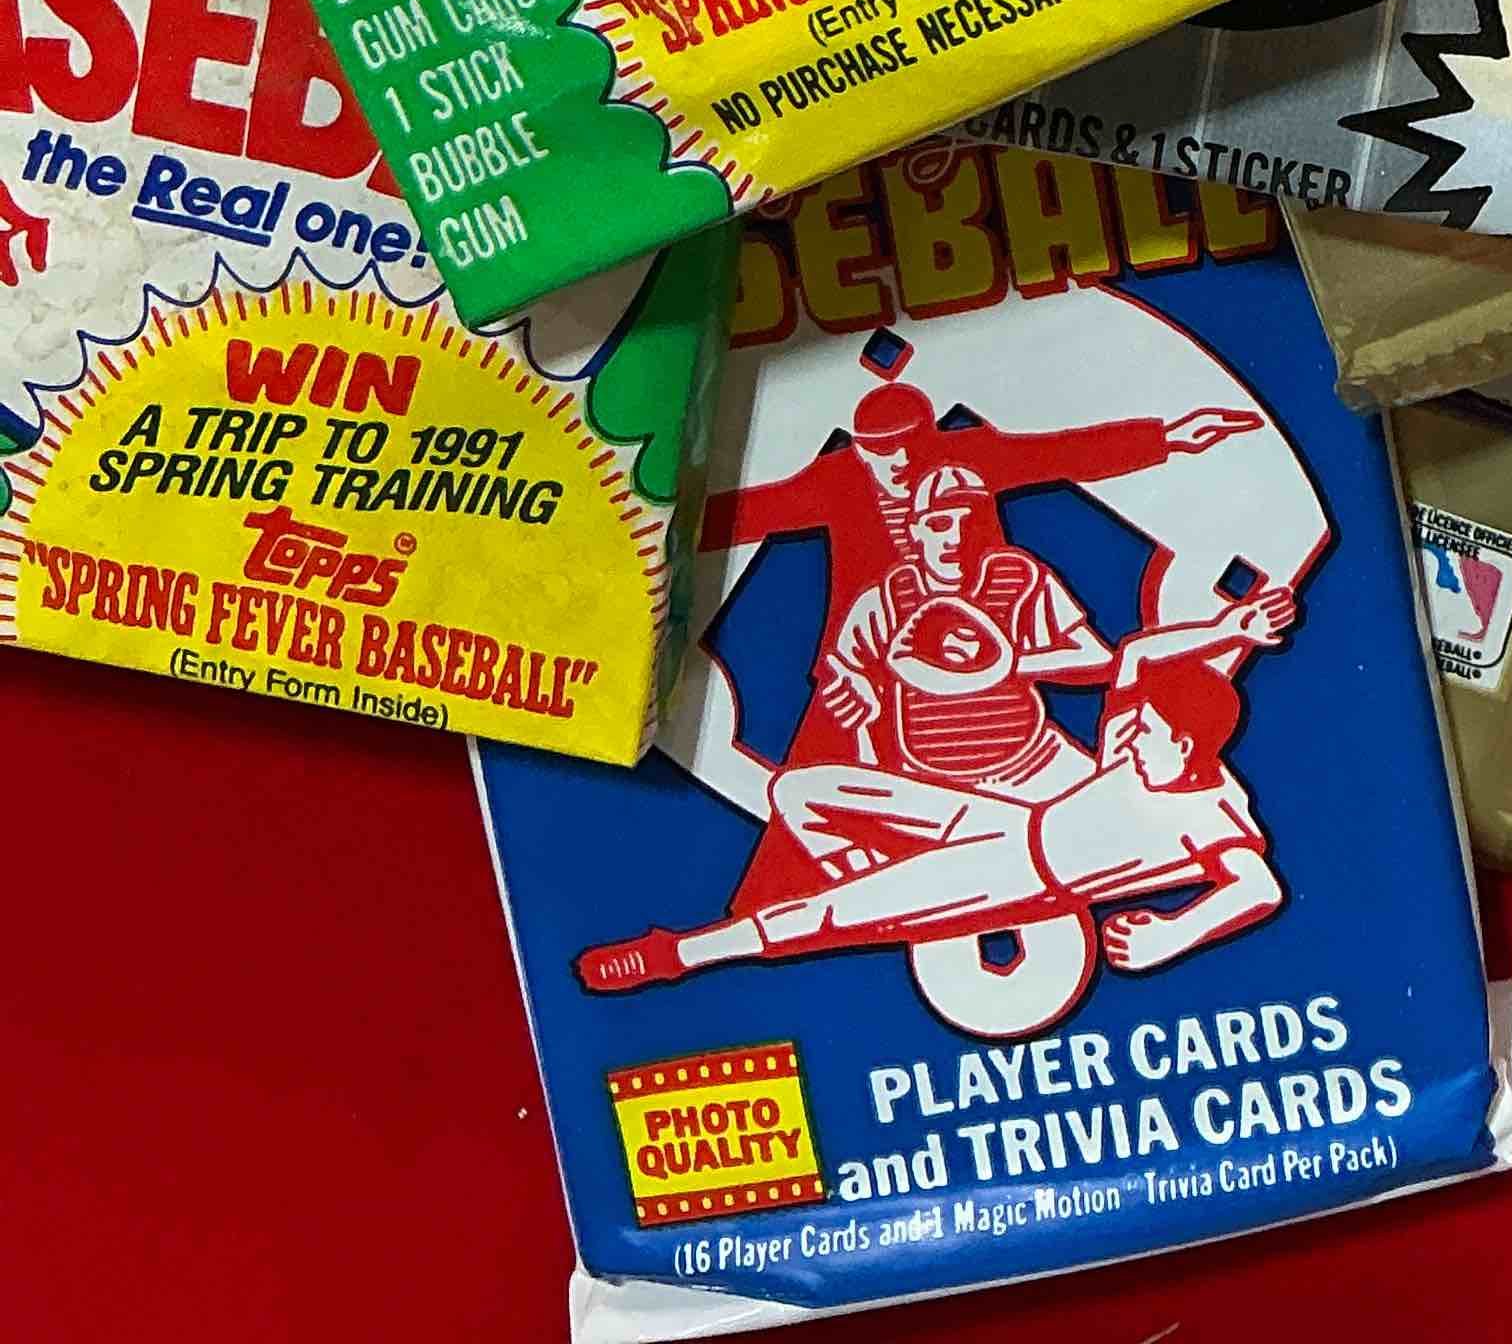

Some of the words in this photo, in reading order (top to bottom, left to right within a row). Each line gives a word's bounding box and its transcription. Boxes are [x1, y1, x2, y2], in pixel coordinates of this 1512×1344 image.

[352, 2, 432, 72] GUM
[420, 42, 525, 121] STICK
[710, 88, 763, 137] NO
[766, 24, 921, 120] PURCHASE
[408, 110, 550, 204] BUBBLE
[21, 128, 128, 197] the
[131, 153, 291, 248] Real
[294, 201, 431, 270] one!
[438, 196, 529, 271] GUM
[223, 337, 423, 417] WIN
[119, 407, 165, 450] A
[185, 407, 308, 458] TRIP
[324, 417, 393, 464] TO
[409, 426, 525, 473] 1991
[89, 449, 294, 504] SPRING
[309, 467, 566, 525] TRAINING
[167, 646, 261, 695] (Entry
[264, 669, 342, 709] Form
[351, 681, 451, 733] Inside)
[204, 586, 347, 672] FEVER
[356, 615, 601, 721] BASEBALL"
[868, 1034, 1125, 1127] PLAYER
[1129, 995, 1350, 1082] CARDS
[634, 1125, 805, 1182] QUALITY
[643, 1098, 782, 1145] PHOTO
[835, 1132, 951, 1205] and
[956, 1099, 1185, 1189] TRIVIA
[1190, 1057, 1415, 1152] CARDS
[671, 1240, 712, 1281] (16
[716, 1231, 795, 1274] Player
[798, 1218, 873, 1262] Cards
[952, 1195, 1030, 1239] Magic
[1032, 1183, 1123, 1225] Motion
[1141, 1166, 1214, 1208] Trivia
[1218, 1154, 1277, 1196] Card
[1280, 1148, 1322, 1188] Per
[1326, 1138, 1402, 1185] Pack)
